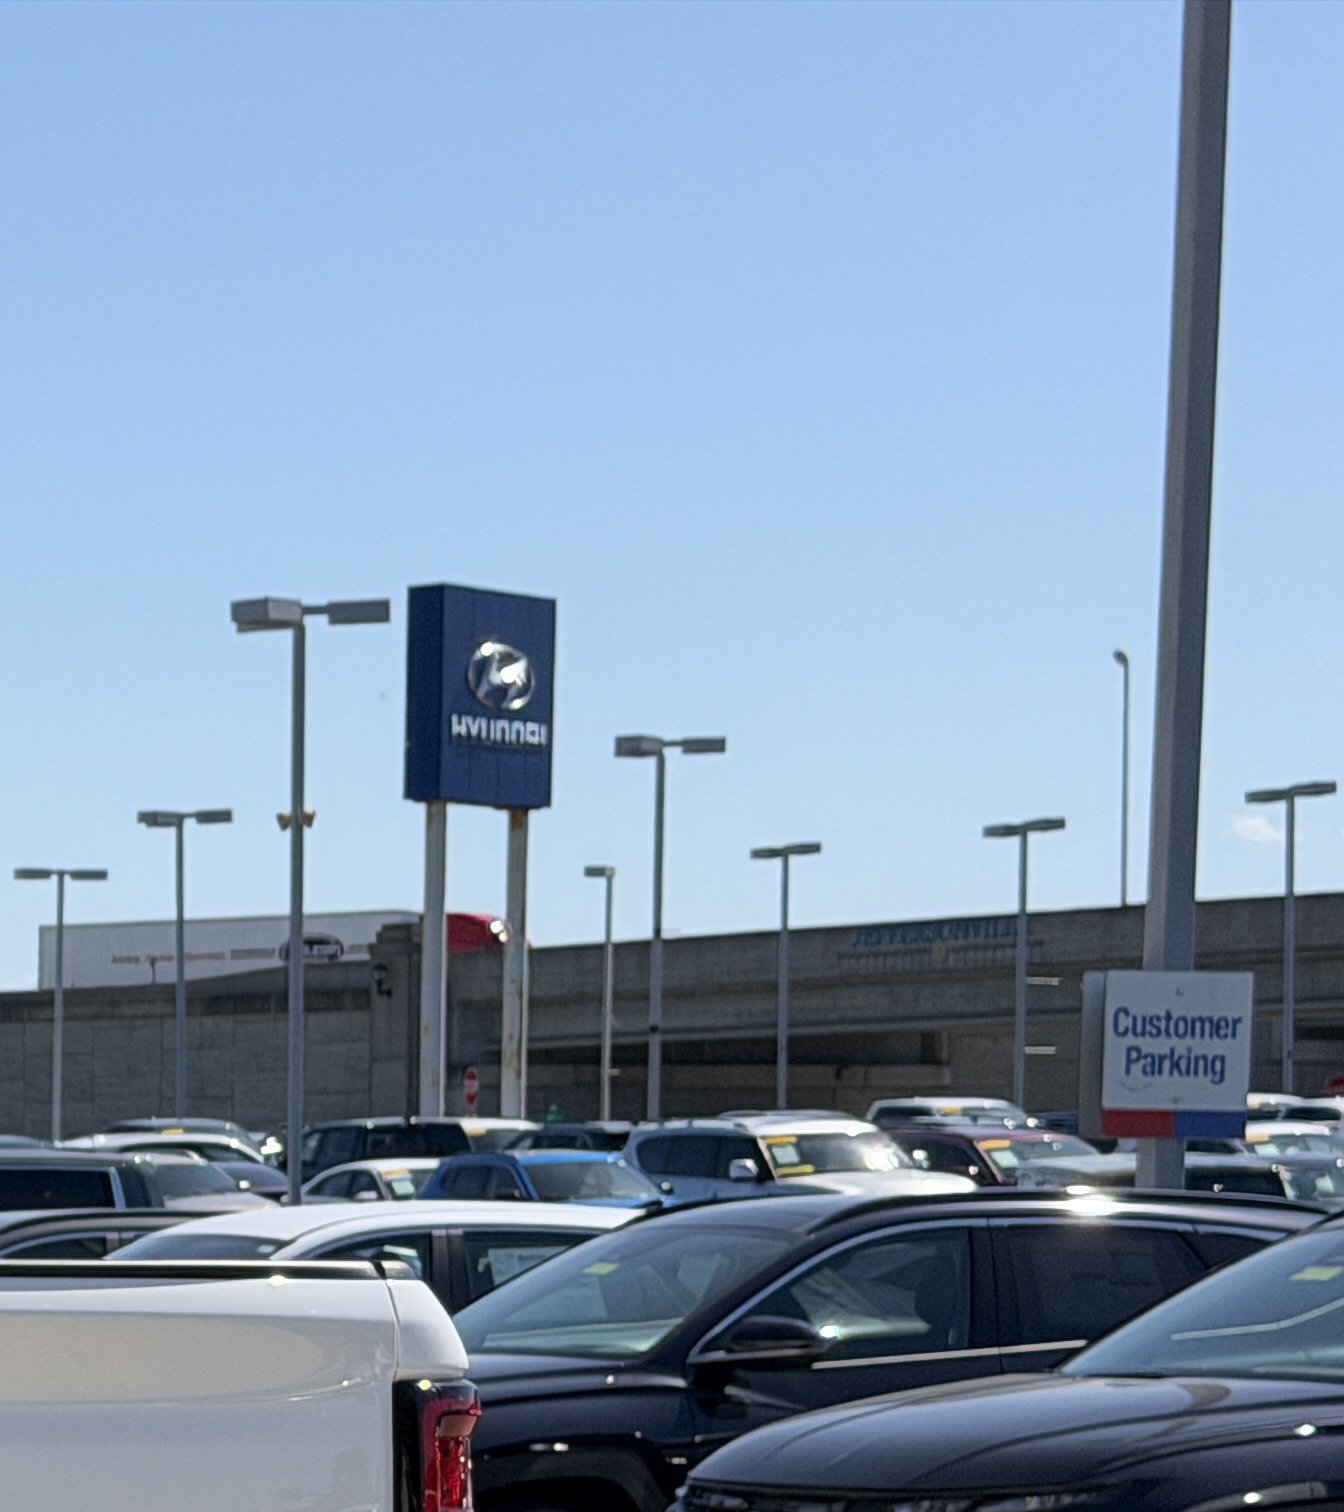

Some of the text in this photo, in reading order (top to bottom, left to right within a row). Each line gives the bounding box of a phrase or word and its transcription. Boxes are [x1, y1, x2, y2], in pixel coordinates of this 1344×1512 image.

[451, 713, 548, 746] HYUNDAI
[1113, 1006, 1243, 1040] Customer
[1124, 1045, 1226, 1085] Parking
